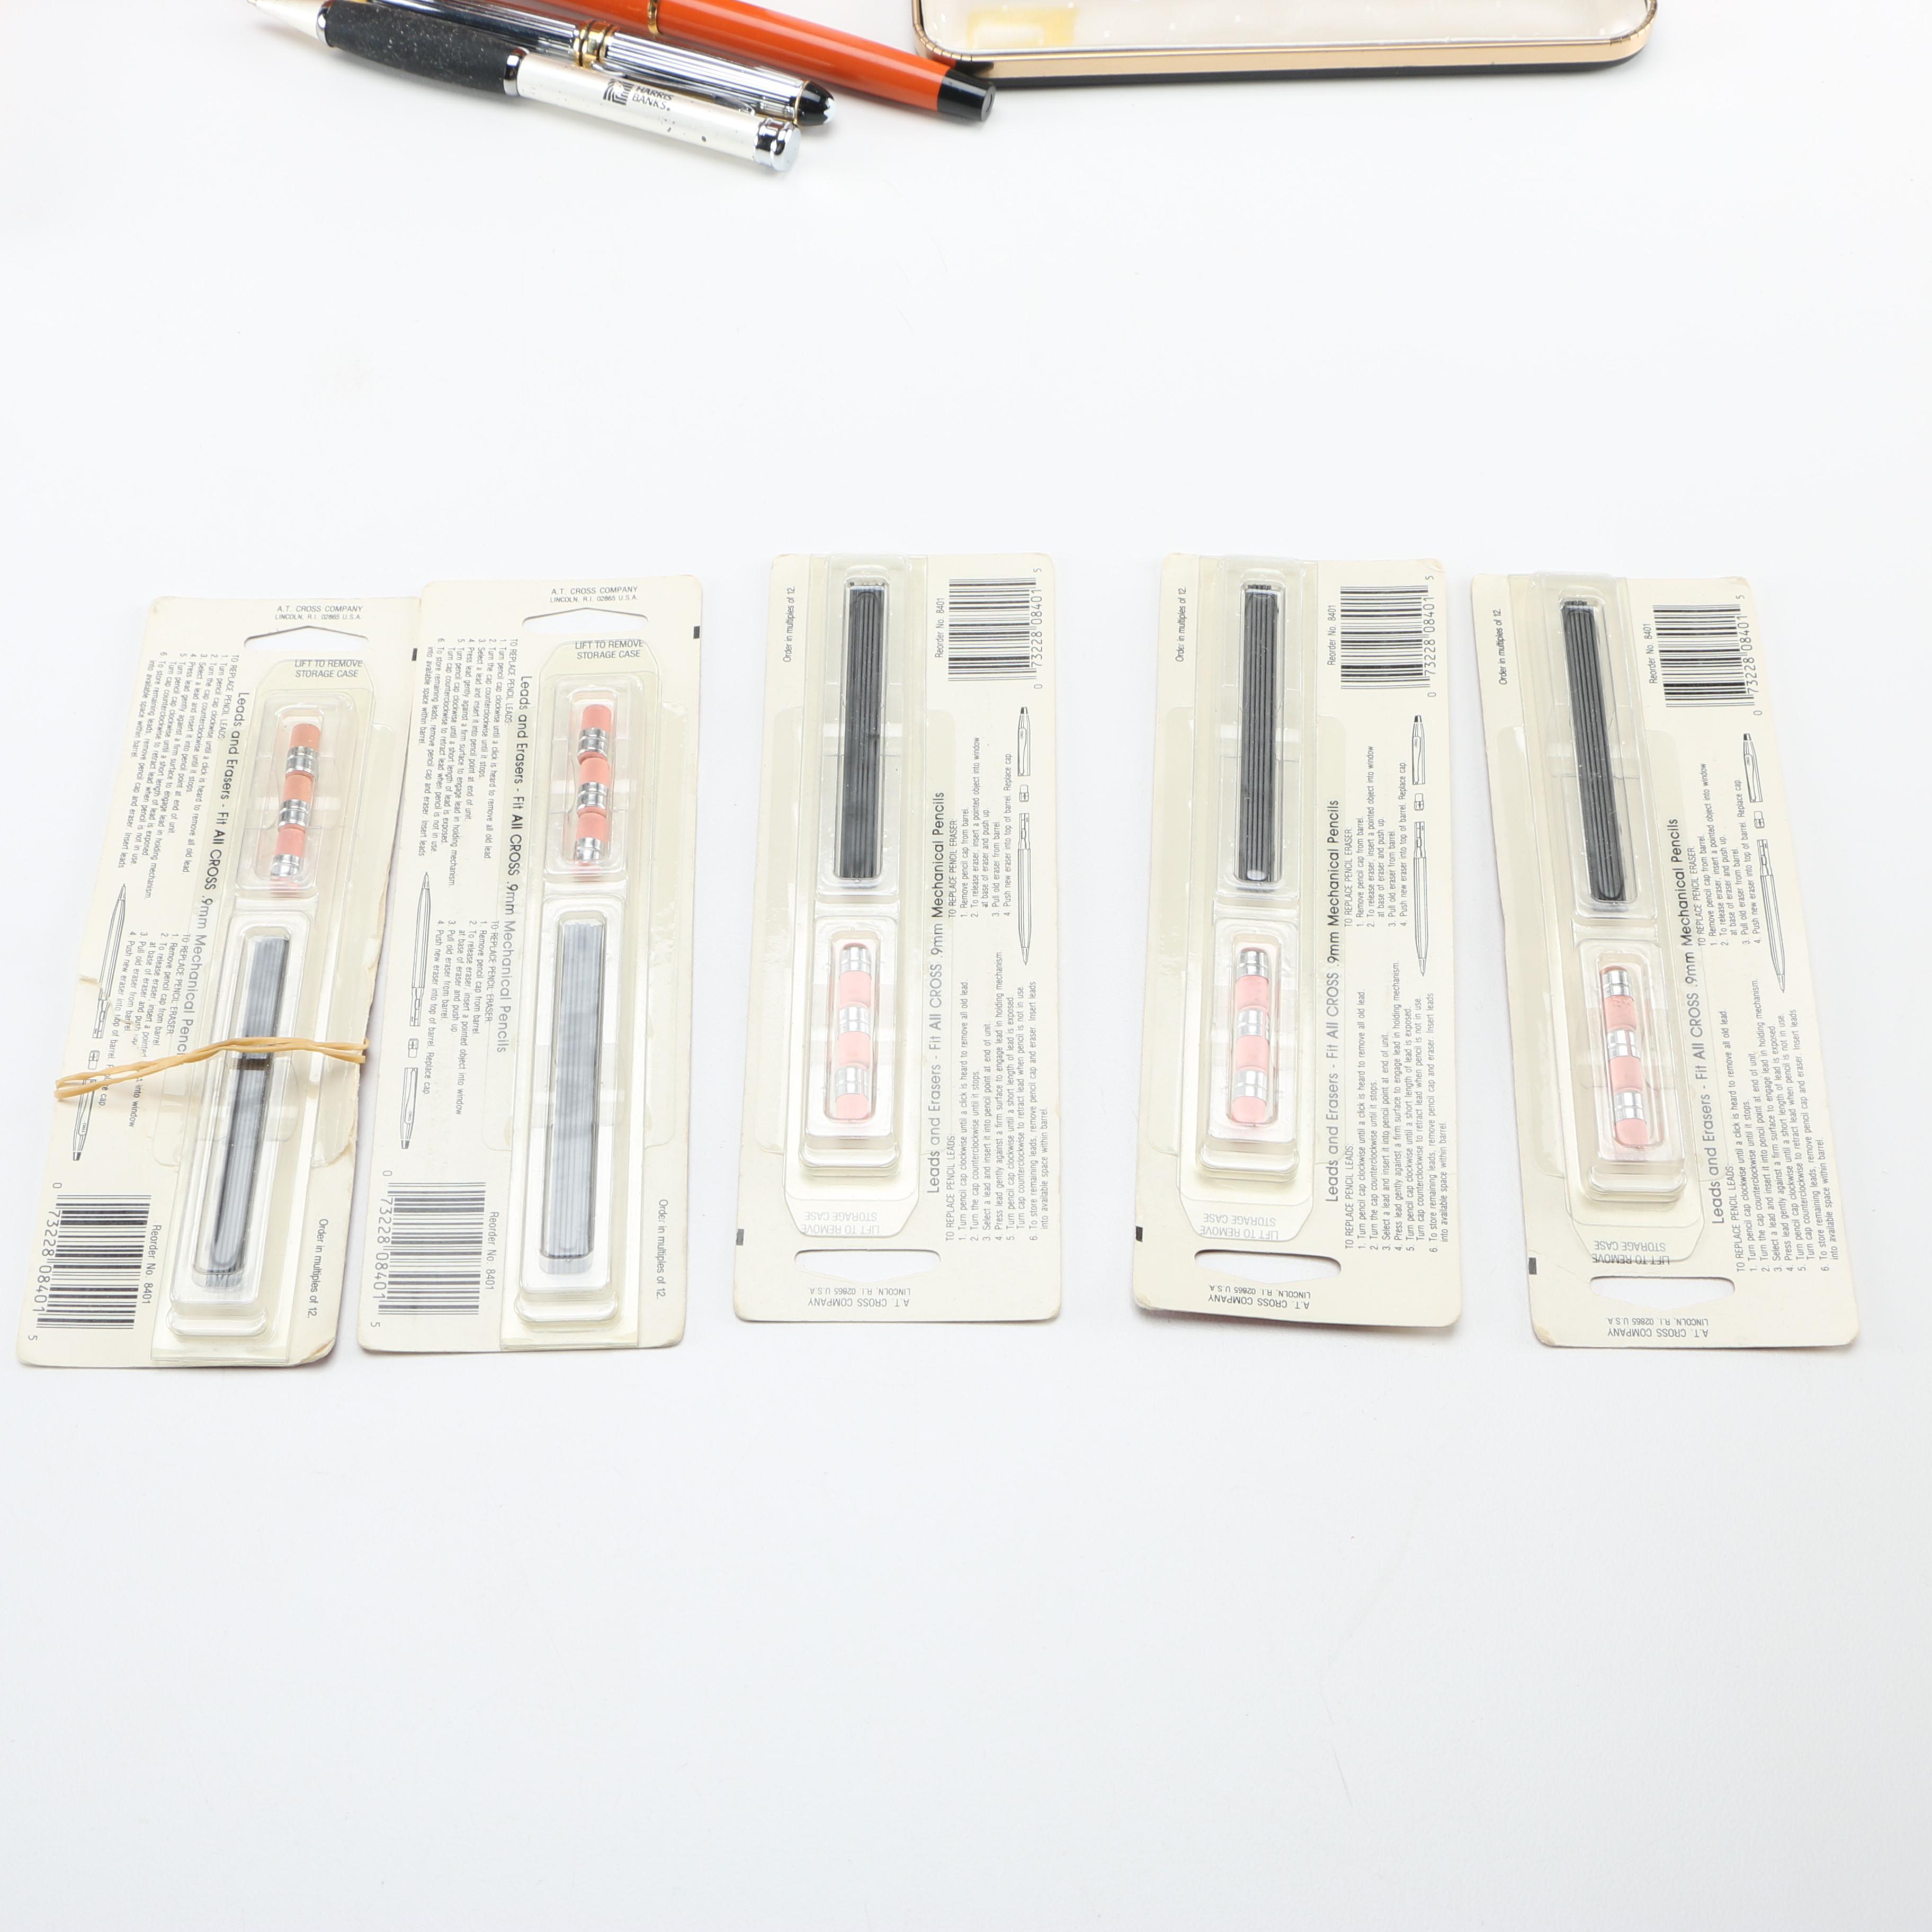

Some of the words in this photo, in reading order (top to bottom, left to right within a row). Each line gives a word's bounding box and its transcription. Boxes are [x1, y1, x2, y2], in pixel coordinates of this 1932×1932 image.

[636, 86, 674, 101] HARRIS
[785, 605, 795, 633] multiples
[935, 598, 945, 613] 8401
[1031, 589, 1042, 625] 08401
[1177, 605, 1187, 633] multiples
[1327, 605, 1336, 621] 8401
[1423, 597, 1435, 633] 08401
[934, 631, 944, 658] Reorder
[1495, 627, 1506, 656] multiples
[1642, 623, 1652, 639] 8401
[1736, 616, 1752, 651] 08401
[294, 659, 312, 667] LIFT
[314, 659, 325, 667] TO
[327, 658, 362, 667] REMOVE
[782, 643, 792, 662] Order
[1031, 631, 1042, 667] 73228
[1327, 638, 1336, 665] Reorder
[1424, 639, 1436, 676] 73228
[1498, 665, 1507, 685] Order
[1647, 657, 1658, 683] Reorder
[1743, 657, 1759, 694] 73228
[518, 676, 532, 710] Leads
[232, 692, 249, 727] Leads
[517, 714, 528, 738] and
[228, 730, 240, 754] and
[514, 743, 527, 784] Erasers
[220, 759, 238, 799] Erasers
[512, 796, 524, 809] Fit
[932, 792, 944, 835] Pencils
[216, 812, 229, 825] Fit
[511, 813, 523, 829] All
[1327, 800, 1339, 843] Pencils
[212, 829, 226, 844] All
[1355, 838, 1364, 853] from
[1666, 819, 1683, 862] Pencils
[204, 849, 222, 890] CROSS
[507, 834, 522, 875] CROSS
[949, 849, 957, 873] PENCIL
[1357, 856, 1365, 867] cap
[931, 840, 944, 917] Mechanical
[948, 875, 957, 906] REPLACE
[1327, 848, 1339, 926] Mechanical
[1356, 870, 1365, 889] pencil
[197, 895, 213, 928] .9mm
[505, 881, 518, 915] .9mm
[947, 908, 956, 918] TO
[1355, 891, 1364, 917] Remove
[1671, 868, 1693, 945] Mechanical
[931, 923, 943, 958] .9mm
[1327, 932, 1339, 966] .9mm
[183, 935, 207, 1013] Mechanical
[500, 920, 515, 999] Mechanical
[1685, 952, 1697, 986] .9mm
[929, 964, 942, 1008] CROSS
[1326, 972, 1339, 1016] CROSS
[497, 1006, 511, 1052] Pencils
[929, 1014, 941, 1030] All
[1686, 992, 1703, 1037] CROSS
[177, 1019, 194, 1055] Penci
[928, 1036, 941, 1049] Fit
[1326, 1022, 1338, 1039] All
[1326, 1044, 1337, 1058] Fit
[1692, 1043, 1705, 1060] All
[1695, 1065, 1707, 1079] Fit
[928, 1065, 941, 1111] Erasers
[1326, 1073, 1338, 1120] Erasers
[928, 1117, 940, 1145] and
[1701, 1094, 1714, 1141] Erasers
[1326, 1126, 1338, 1154] and
[926, 1150, 940, 1193] Leads
[1704, 1147, 1719, 1175] and
[1325, 1160, 1338, 1201] Leads
[1708, 1181, 1724, 1223] Leads
[1728, 1193, 1739, 1221] PENCIL
[42, 1210, 61, 1257] 73228
[316, 1218, 328, 1242] Order
[377, 1197, 393, 1244] 73228
[487, 1211, 499, 1245] Reorder
[148, 1224, 162, 1258] Reorder
[654, 1236, 666, 1273] multiples
[1731, 1224, 1743, 1258] REPLACE
[309, 1255, 322, 1292] multiples
[373, 1252, 389, 1299] 08401
[485, 1268, 496, 1289] 8401
[1736, 1262, 1745, 1272] TO
[33, 1265, 52, 1312] 08401
[141, 1282, 154, 1303] 8401
[309, 1295, 318, 1303] of
[808, 1298, 853, 1307] COMPANY
[856, 1298, 887, 1307] CROSS
[1208, 1294, 1253, 1305] COMPANY
[1257, 1298, 1287, 1308] CROSS
[1607, 1328, 1652, 1337] COMPANY
[1656, 1328, 1686, 1337] CROSS
